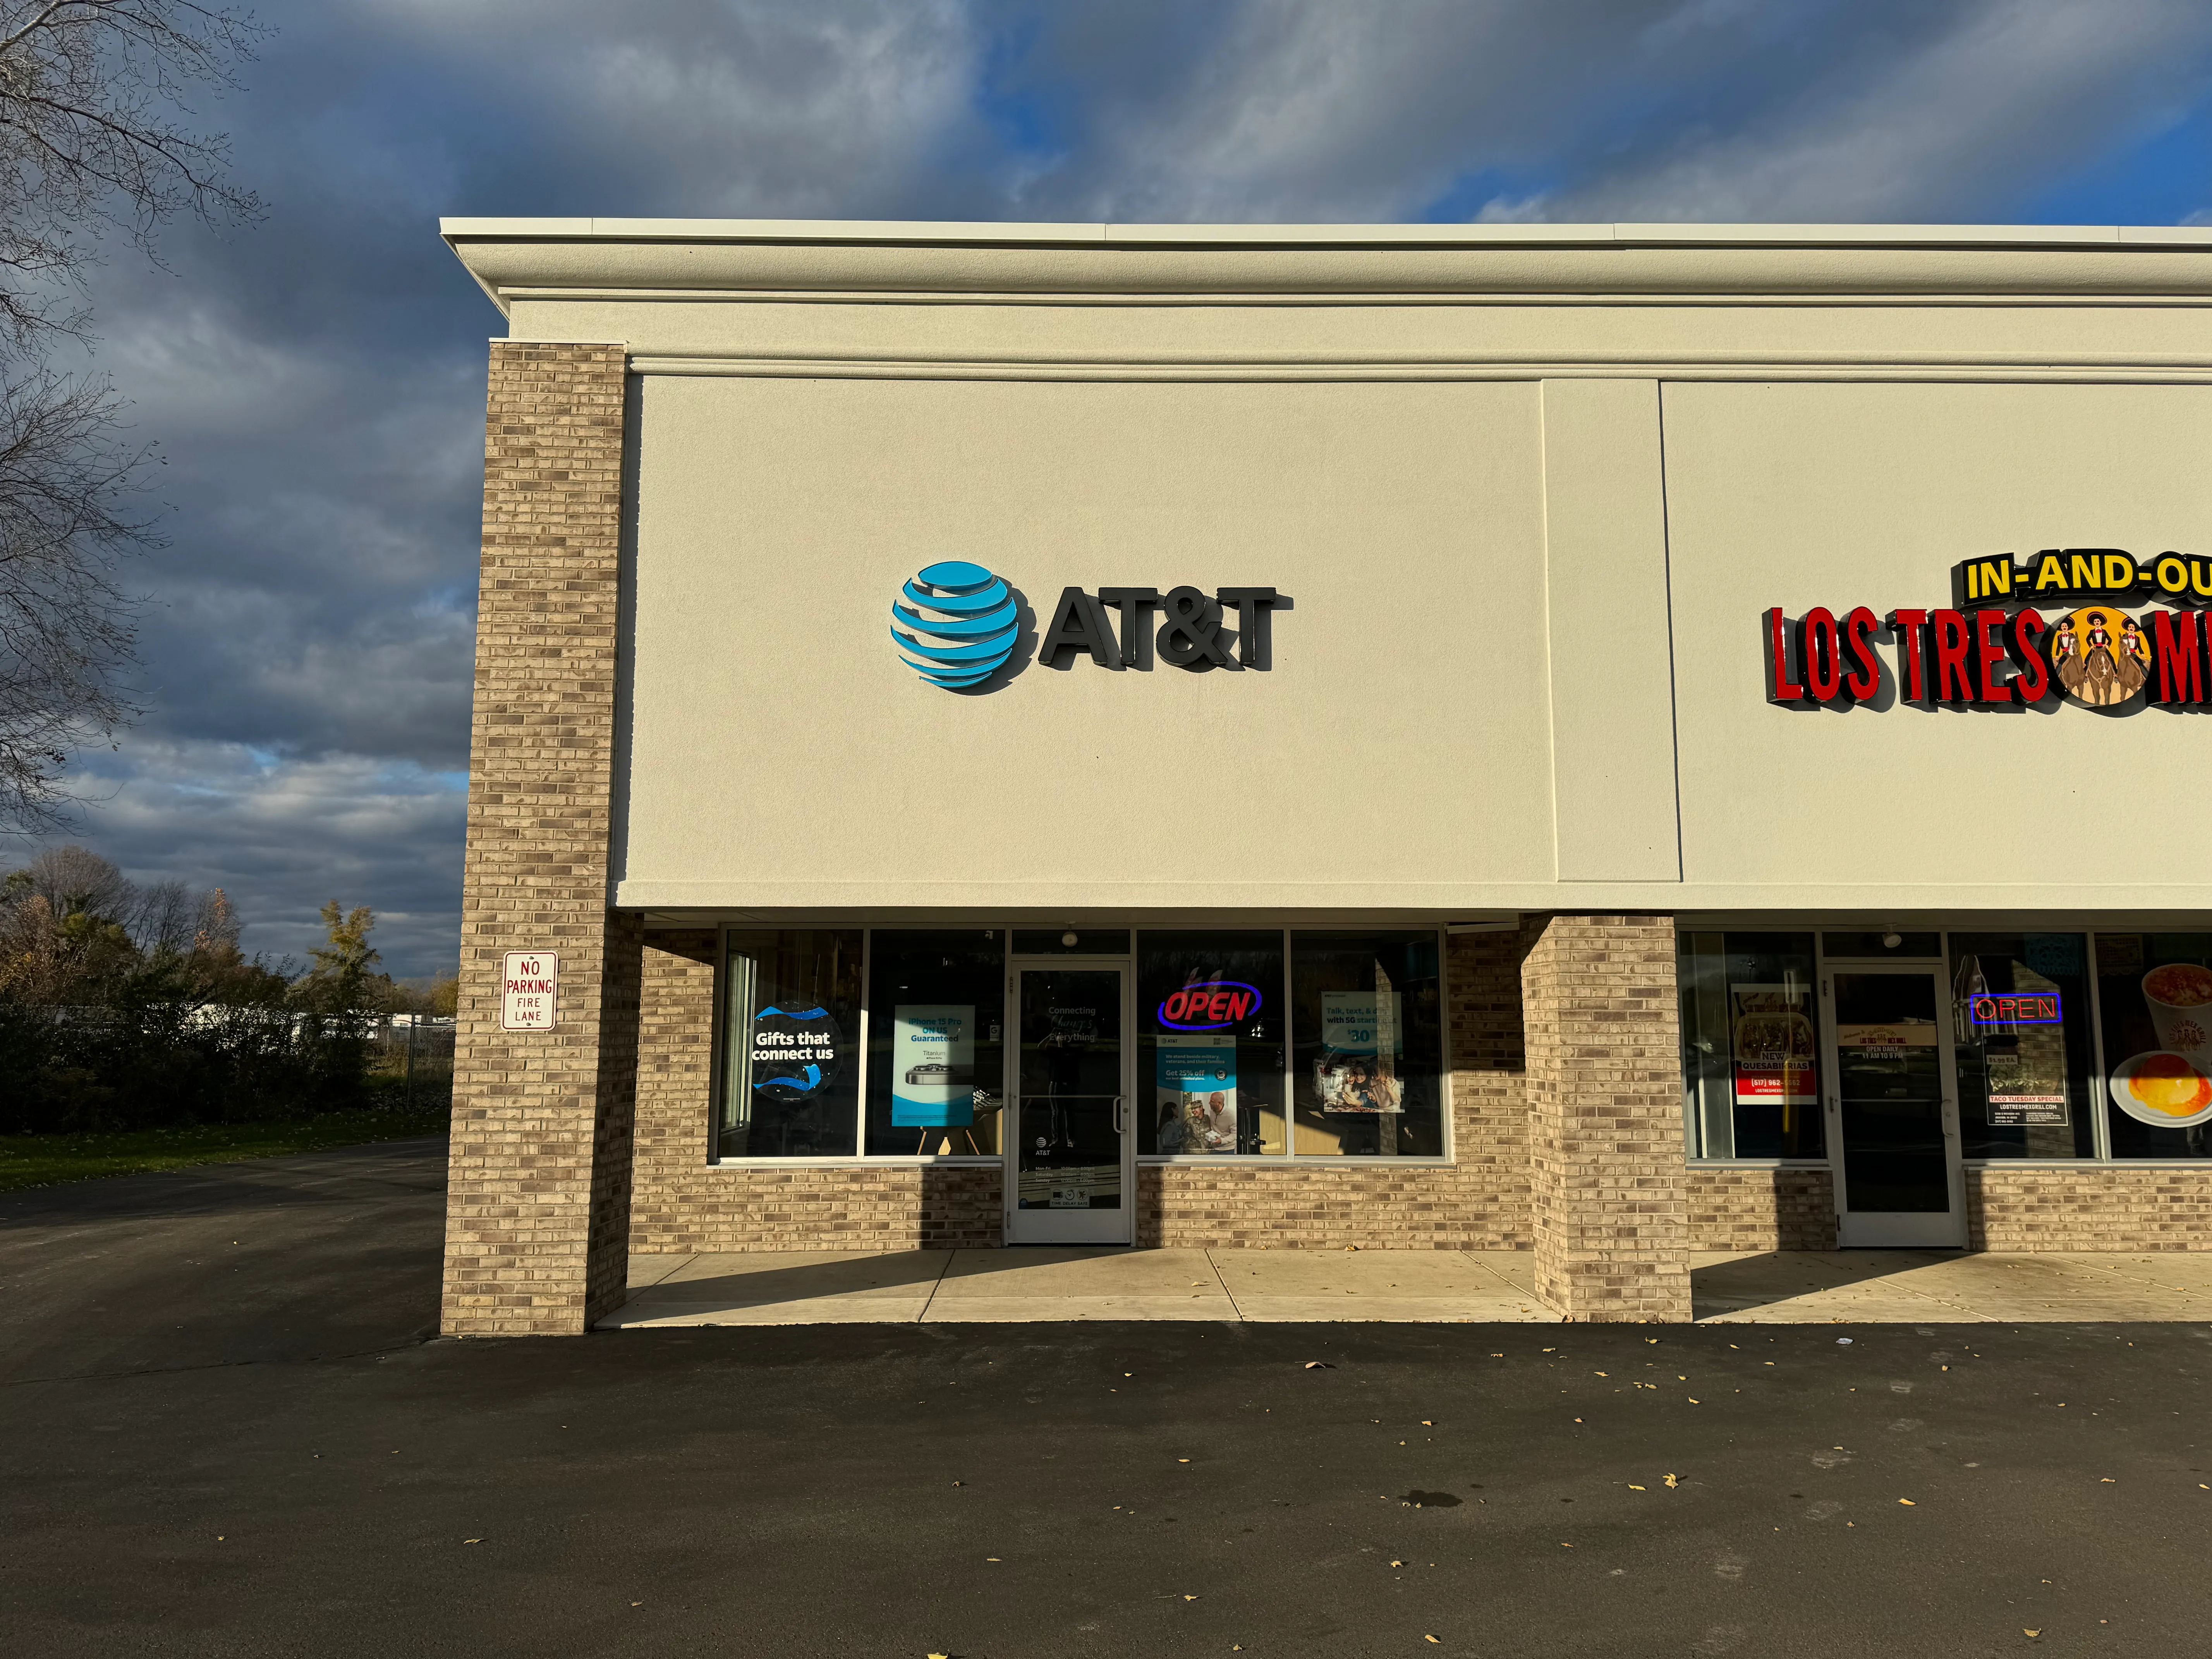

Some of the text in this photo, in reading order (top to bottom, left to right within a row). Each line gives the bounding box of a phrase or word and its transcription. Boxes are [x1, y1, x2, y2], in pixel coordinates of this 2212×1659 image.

[1038, 586, 1276, 666] AT&T
[1772, 606, 1880, 701] LOS
[1896, 608, 2048, 702] TRES
[521, 961, 540, 975] NO
[507, 979, 552, 994] PARKING
[517, 998, 540, 1007] FIRE
[1165, 992, 1251, 1020] OPEN
[1976, 999, 2055, 1019] OPEN
[515, 1012, 541, 1021] LANE
[1049, 1006, 1096, 1016] Connecting
[756, 1031, 830, 1046] Gifts that
[1049, 1033, 1095, 1042] Everything
[1347, 1029, 1370, 1042] $30
[752, 1048, 834, 1060] connect us
[1752, 1079, 1767, 1087] (517)
